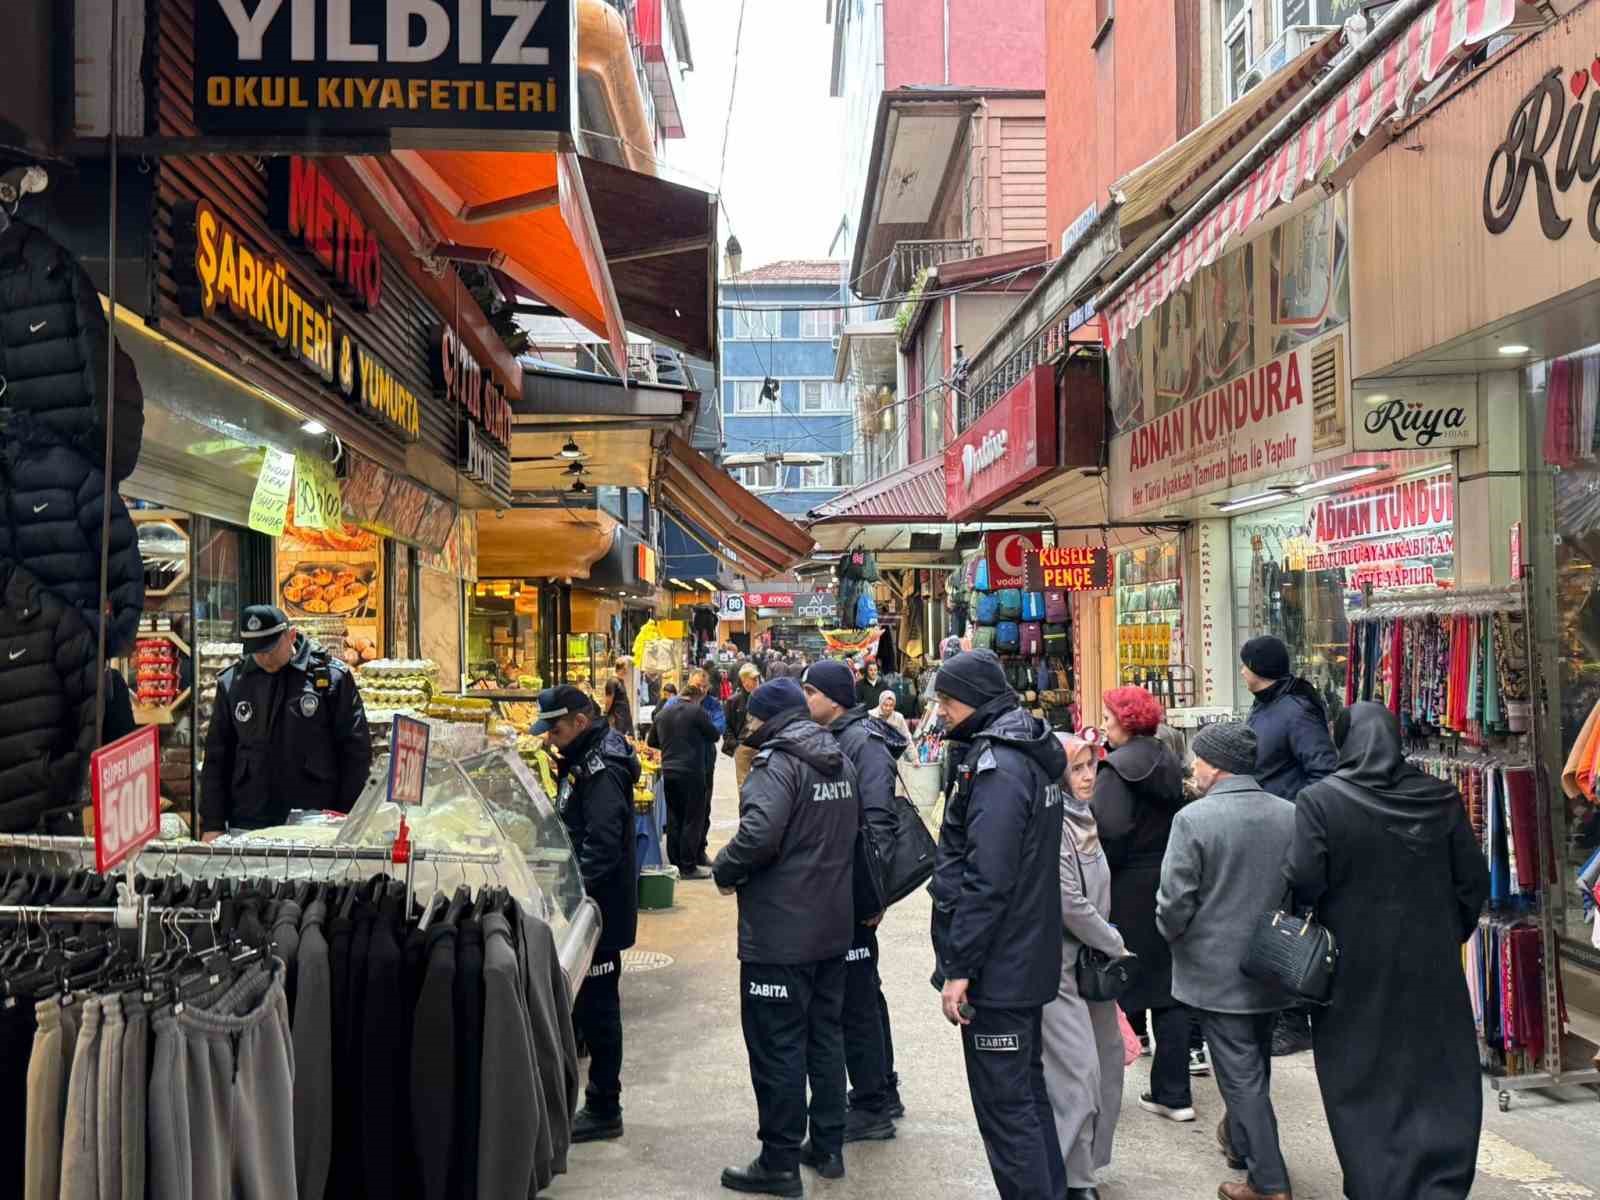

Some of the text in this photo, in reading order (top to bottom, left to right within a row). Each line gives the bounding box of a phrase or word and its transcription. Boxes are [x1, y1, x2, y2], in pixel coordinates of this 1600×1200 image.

[217, 0, 550, 64] YILDIZ
[207, 76, 557, 113] OKUL KIYAFETLERİ
[1483, 53, 1600, 241] Rü
[289, 155, 382, 306] METRO
[199, 210, 419, 437] ŞARKÜTERİ & YUMURTA
[1130, 408, 1184, 472] ADNAN
[1190, 352, 1304, 448] KUNDURA
[1364, 399, 1466, 446] Rüya
[1316, 490, 1371, 543] ADNAN
[1307, 552, 1325, 570] HER
[1363, 536, 1425, 562] AYAKKABI
[1388, 565, 1434, 587] YAPILIR
[798, 605, 837, 616] PERDE
[809, 595, 824, 605] AY
[103, 772, 149, 853] 500
[749, 982, 788, 998] ZABITA
